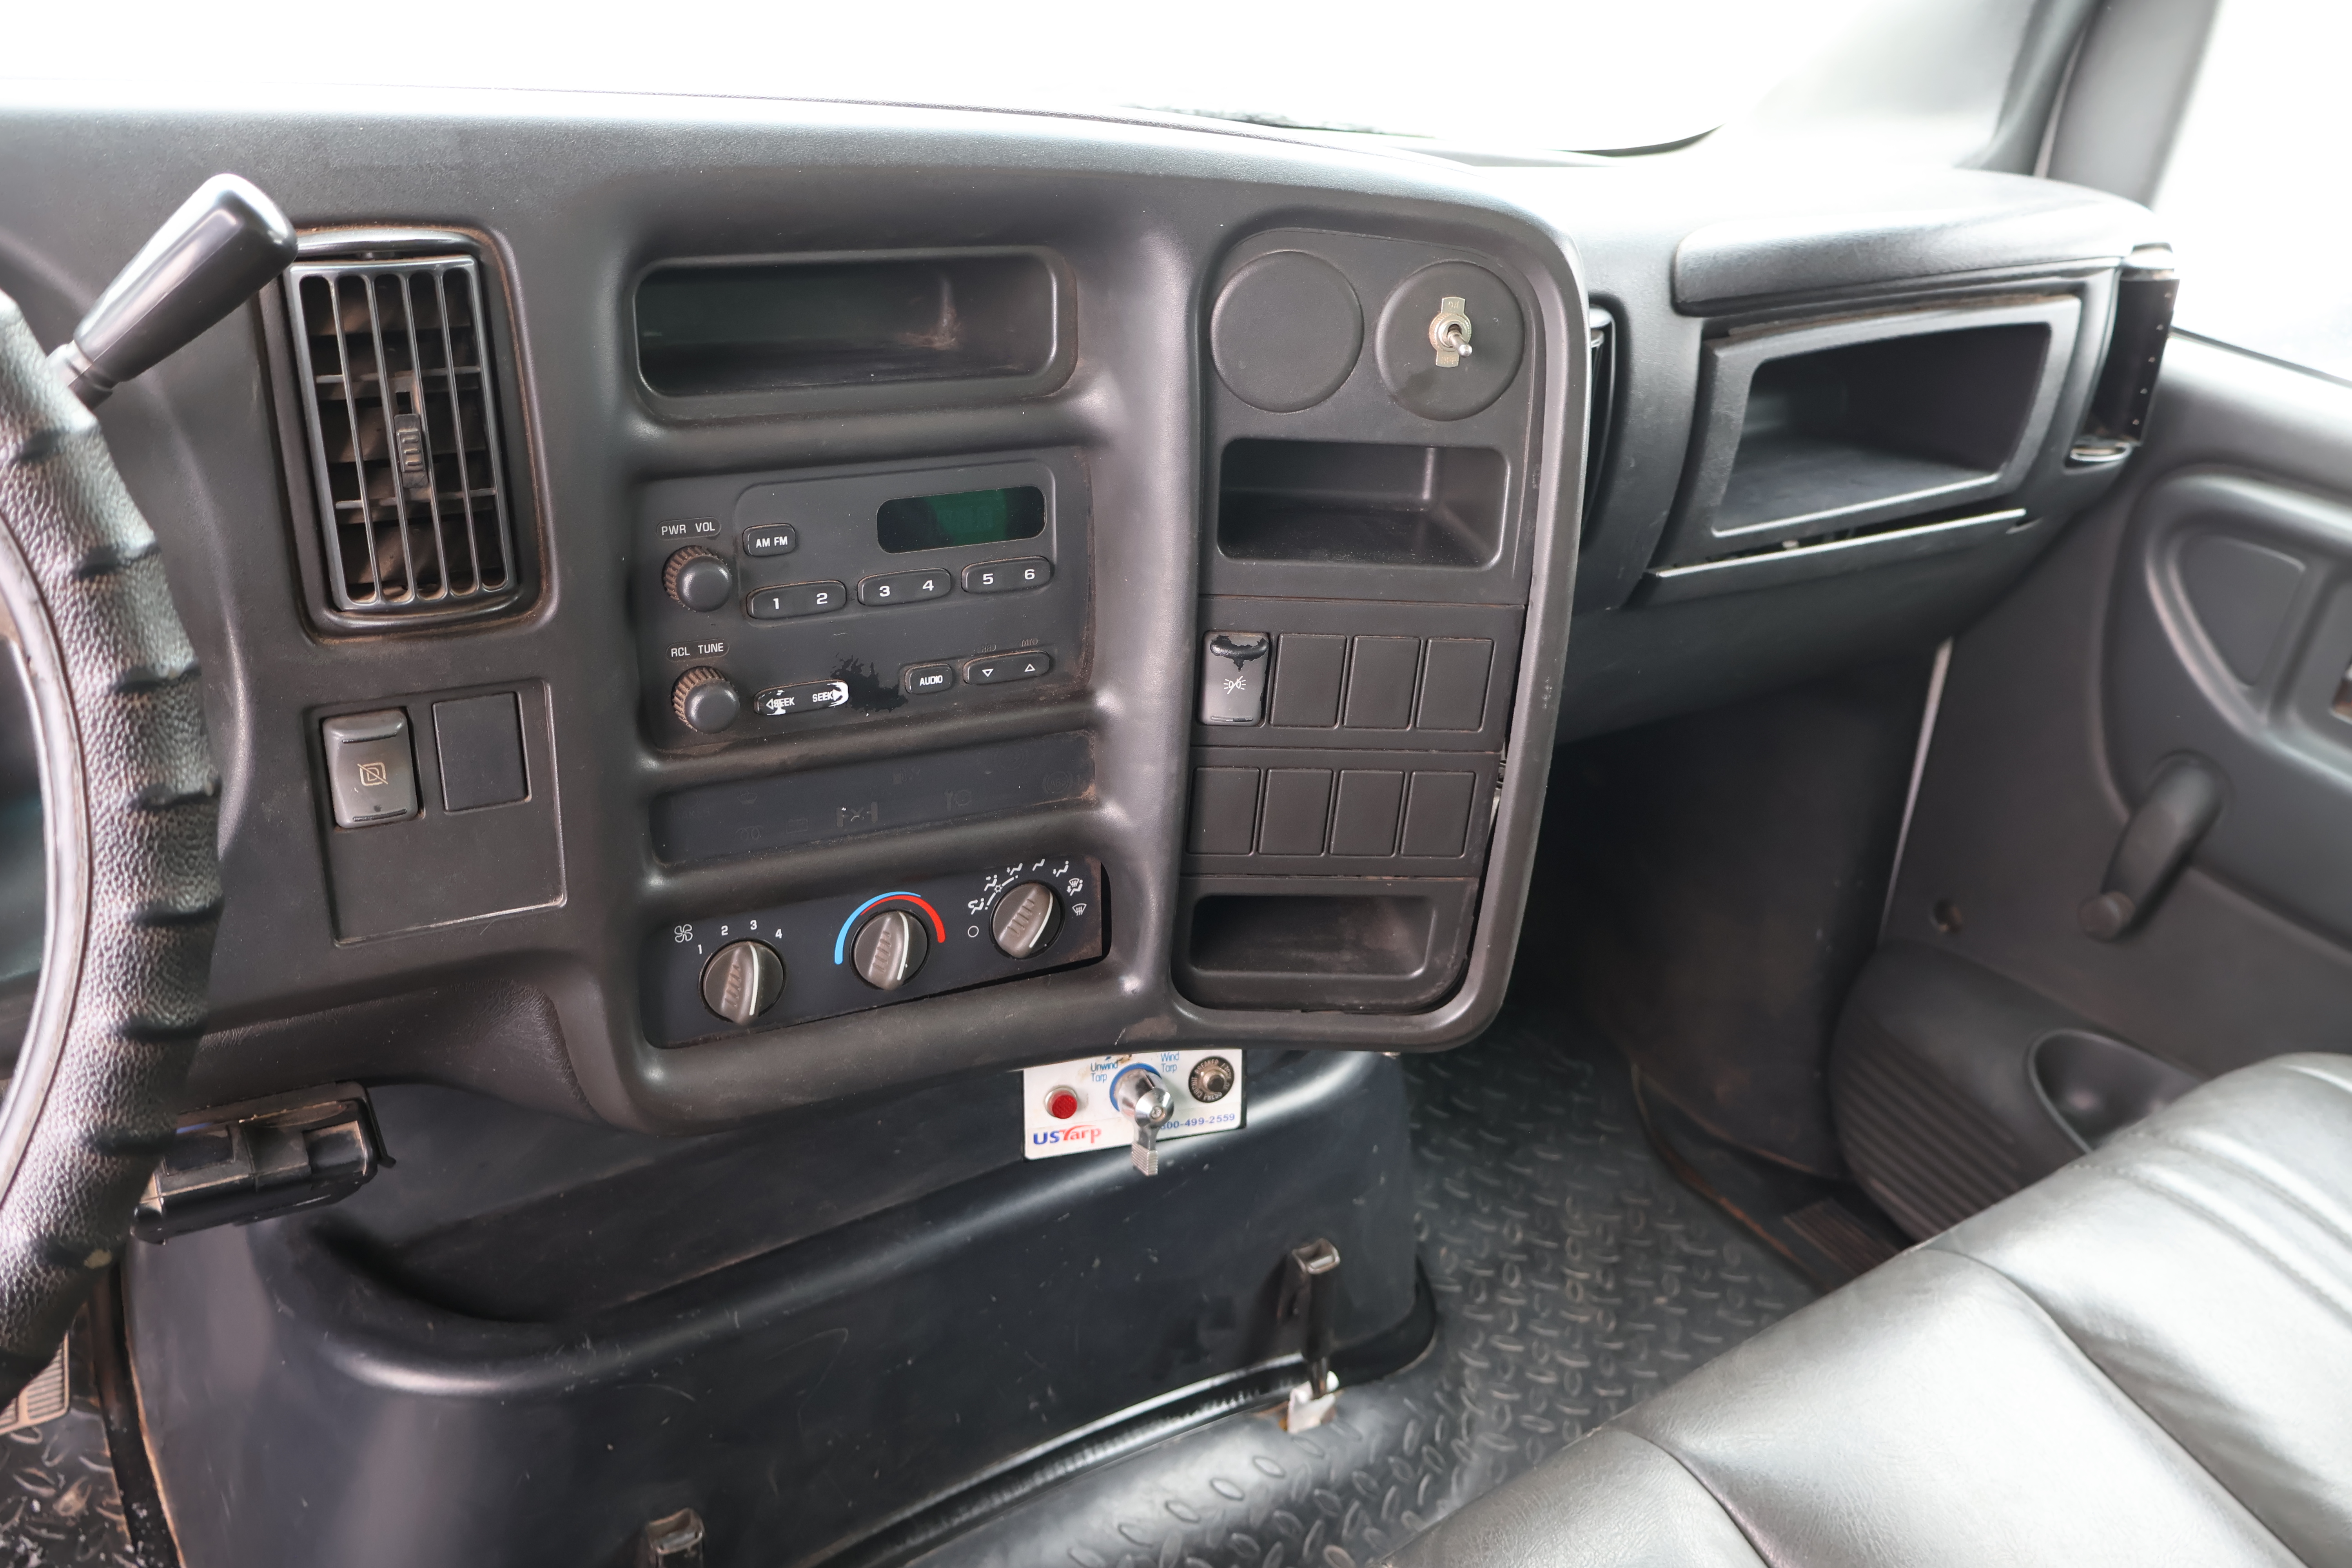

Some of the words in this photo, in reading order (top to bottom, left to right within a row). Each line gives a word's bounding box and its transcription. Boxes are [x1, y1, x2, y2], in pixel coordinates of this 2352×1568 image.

[661, 524, 686, 536] PWR
[695, 521, 715, 532] VOL
[755, 537, 770, 548] AM
[774, 536, 788, 546] FM
[773, 597, 779, 610] 1
[816, 592, 828, 604] 2
[879, 586, 891, 597] 3
[922, 580, 934, 591] 4
[983, 573, 994, 584] 5
[1024, 569, 1035, 580] 6
[671, 646, 690, 657] RCL
[698, 642, 724, 654] TUNE
[919, 675, 943, 686] AUDIO
[812, 691, 833, 702] SEEK
[698, 944, 702, 954] 1
[721, 926, 728, 935] 2
[750, 920, 757, 930] 3
[775, 929, 782, 938] 4
[1161, 1051, 1180, 1062] Wind
[1091, 1062, 1118, 1072] Unwind
[1161, 1063, 1177, 1073] Tarp
[1194, 1059, 1219, 1074] BREAKER
[1091, 1073, 1107, 1083] Tarp
